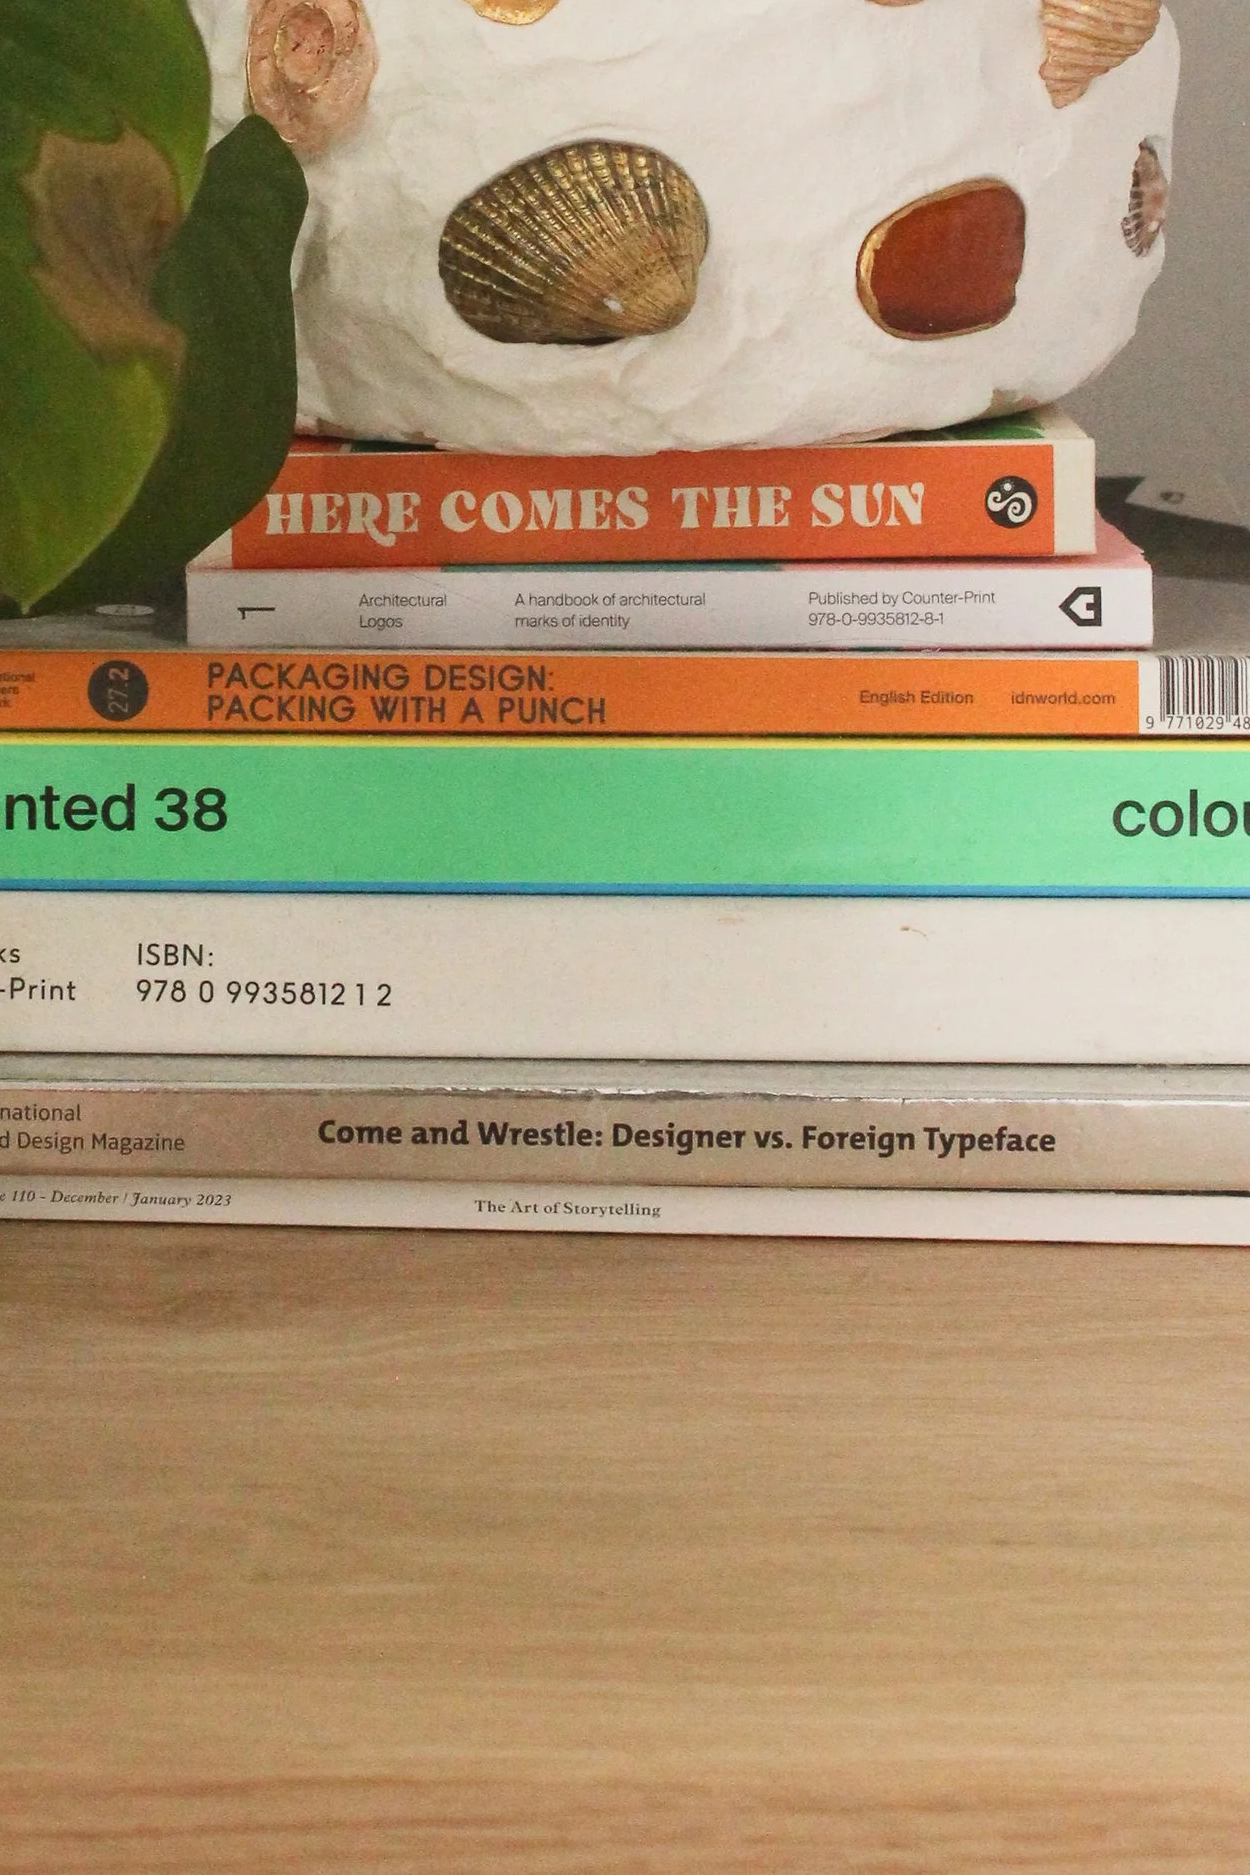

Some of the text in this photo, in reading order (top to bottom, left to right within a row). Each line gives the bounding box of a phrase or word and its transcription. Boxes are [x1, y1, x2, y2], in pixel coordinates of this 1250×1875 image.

[265, 481, 925, 547] HERE COMES THE SUN
[358, 592, 447, 608] Architectural
[514, 592, 706, 607] A handbook of architectural
[808, 590, 996, 609] Published by Counter-Print
[358, 614, 404, 630] Logos
[514, 613, 631, 630] marks of identity
[808, 611, 944, 627] 978-0-9935812-8-1
[207, 661, 554, 692] PACKAGING DESIGN:
[108, 667, 129, 714] 27.2
[859, 689, 974, 707] English Edition
[1010, 690, 1116, 705] idnworld.com
[207, 693, 606, 725] PACKING WITH A PUNCH
[1145, 715, 1155, 730] 9
[1166, 715, 1225, 730] 771029
[154, 787, 228, 833] 38
[1112, 788, 1250, 838] colo
[137, 942, 214, 967] ISBN:
[136, 978, 392, 1007] 978 0 9935812 1 2
[17, 1130, 85, 1155] Design
[91, 1132, 186, 1156] Magazine
[318, 1119, 1057, 1159] Come and Wrestle: Designer vs. Foreign Typeface
[12, 1189, 36, 1203] 110
[50, 1189, 119, 1204] December
[130, 1191, 192, 1207] January
[196, 1193, 232, 1207] 2023
[476, 1199, 661, 1219] The Art of Storytelling
